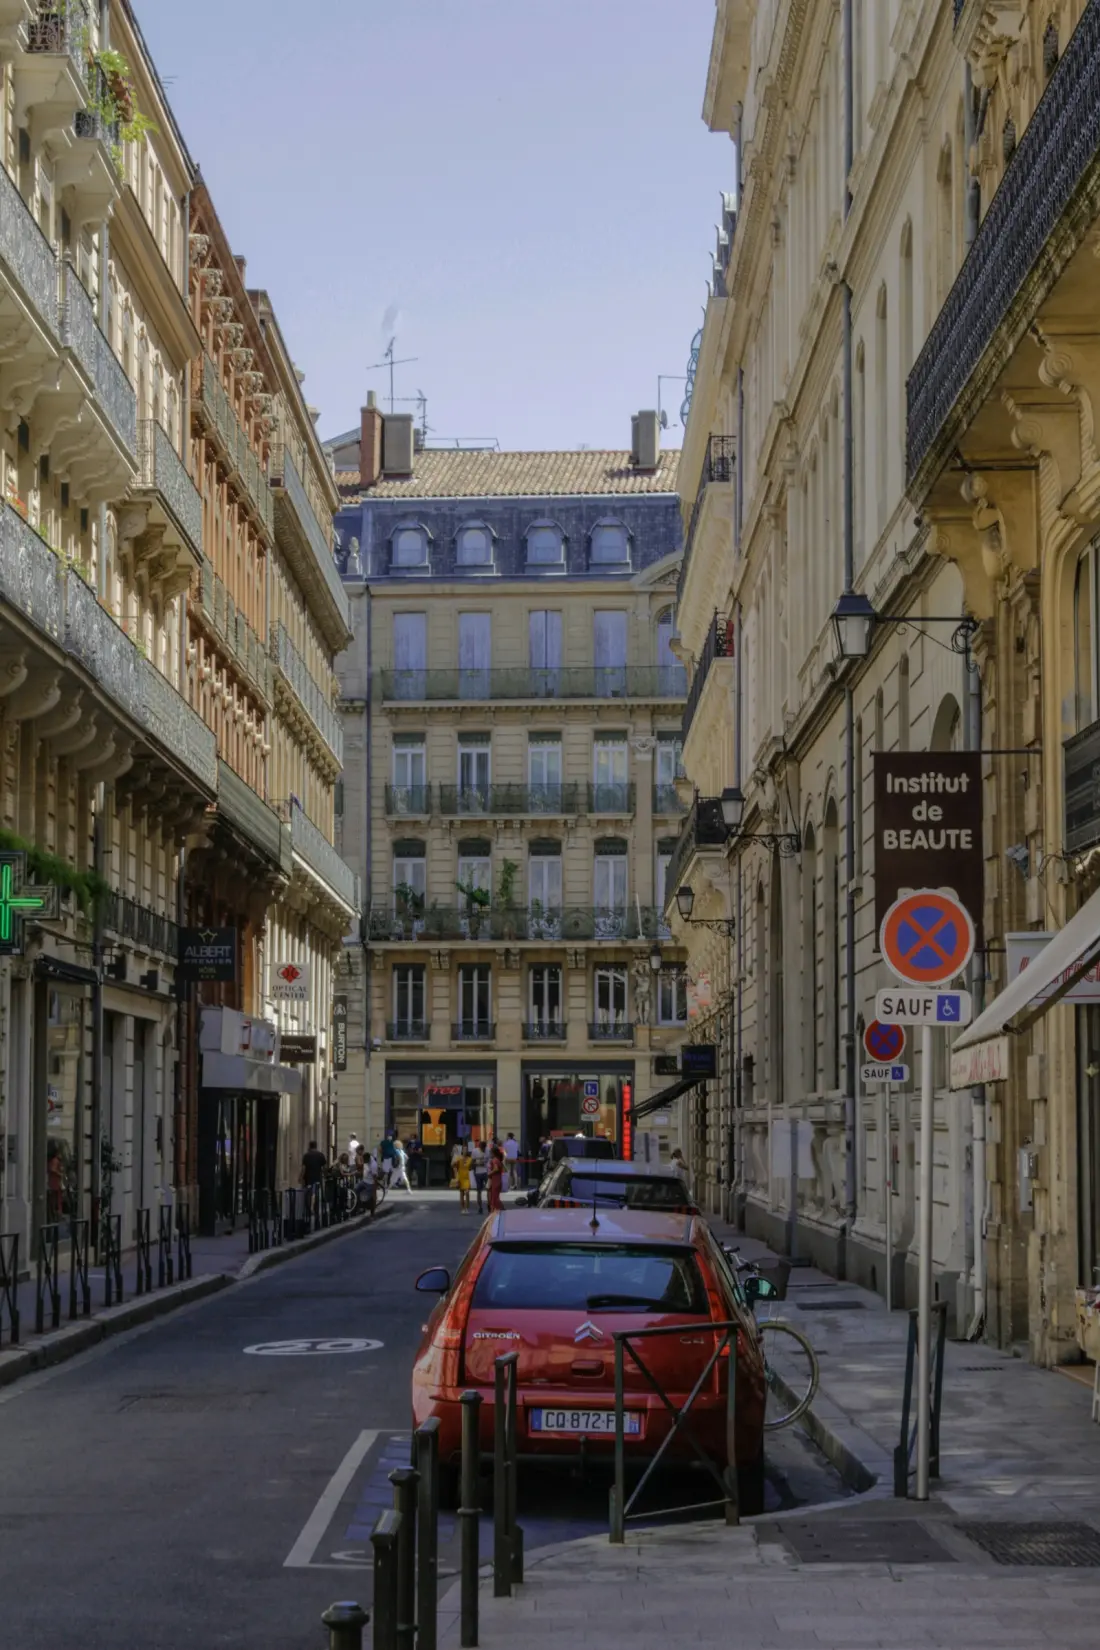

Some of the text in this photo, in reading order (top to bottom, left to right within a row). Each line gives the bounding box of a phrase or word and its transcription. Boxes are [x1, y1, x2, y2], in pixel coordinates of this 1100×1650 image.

[886, 772, 970, 794] Institut
[911, 800, 944, 822] de
[883, 829, 973, 850] BEAUTE
[184, 945, 232, 958] ALBERT
[272, 985, 308, 993] OPTICAL
[273, 992, 305, 1000] CENTER
[882, 997, 933, 1017] SAUF
[337, 1022, 346, 1064] BURTON
[864, 1068, 890, 1079] SAUF
